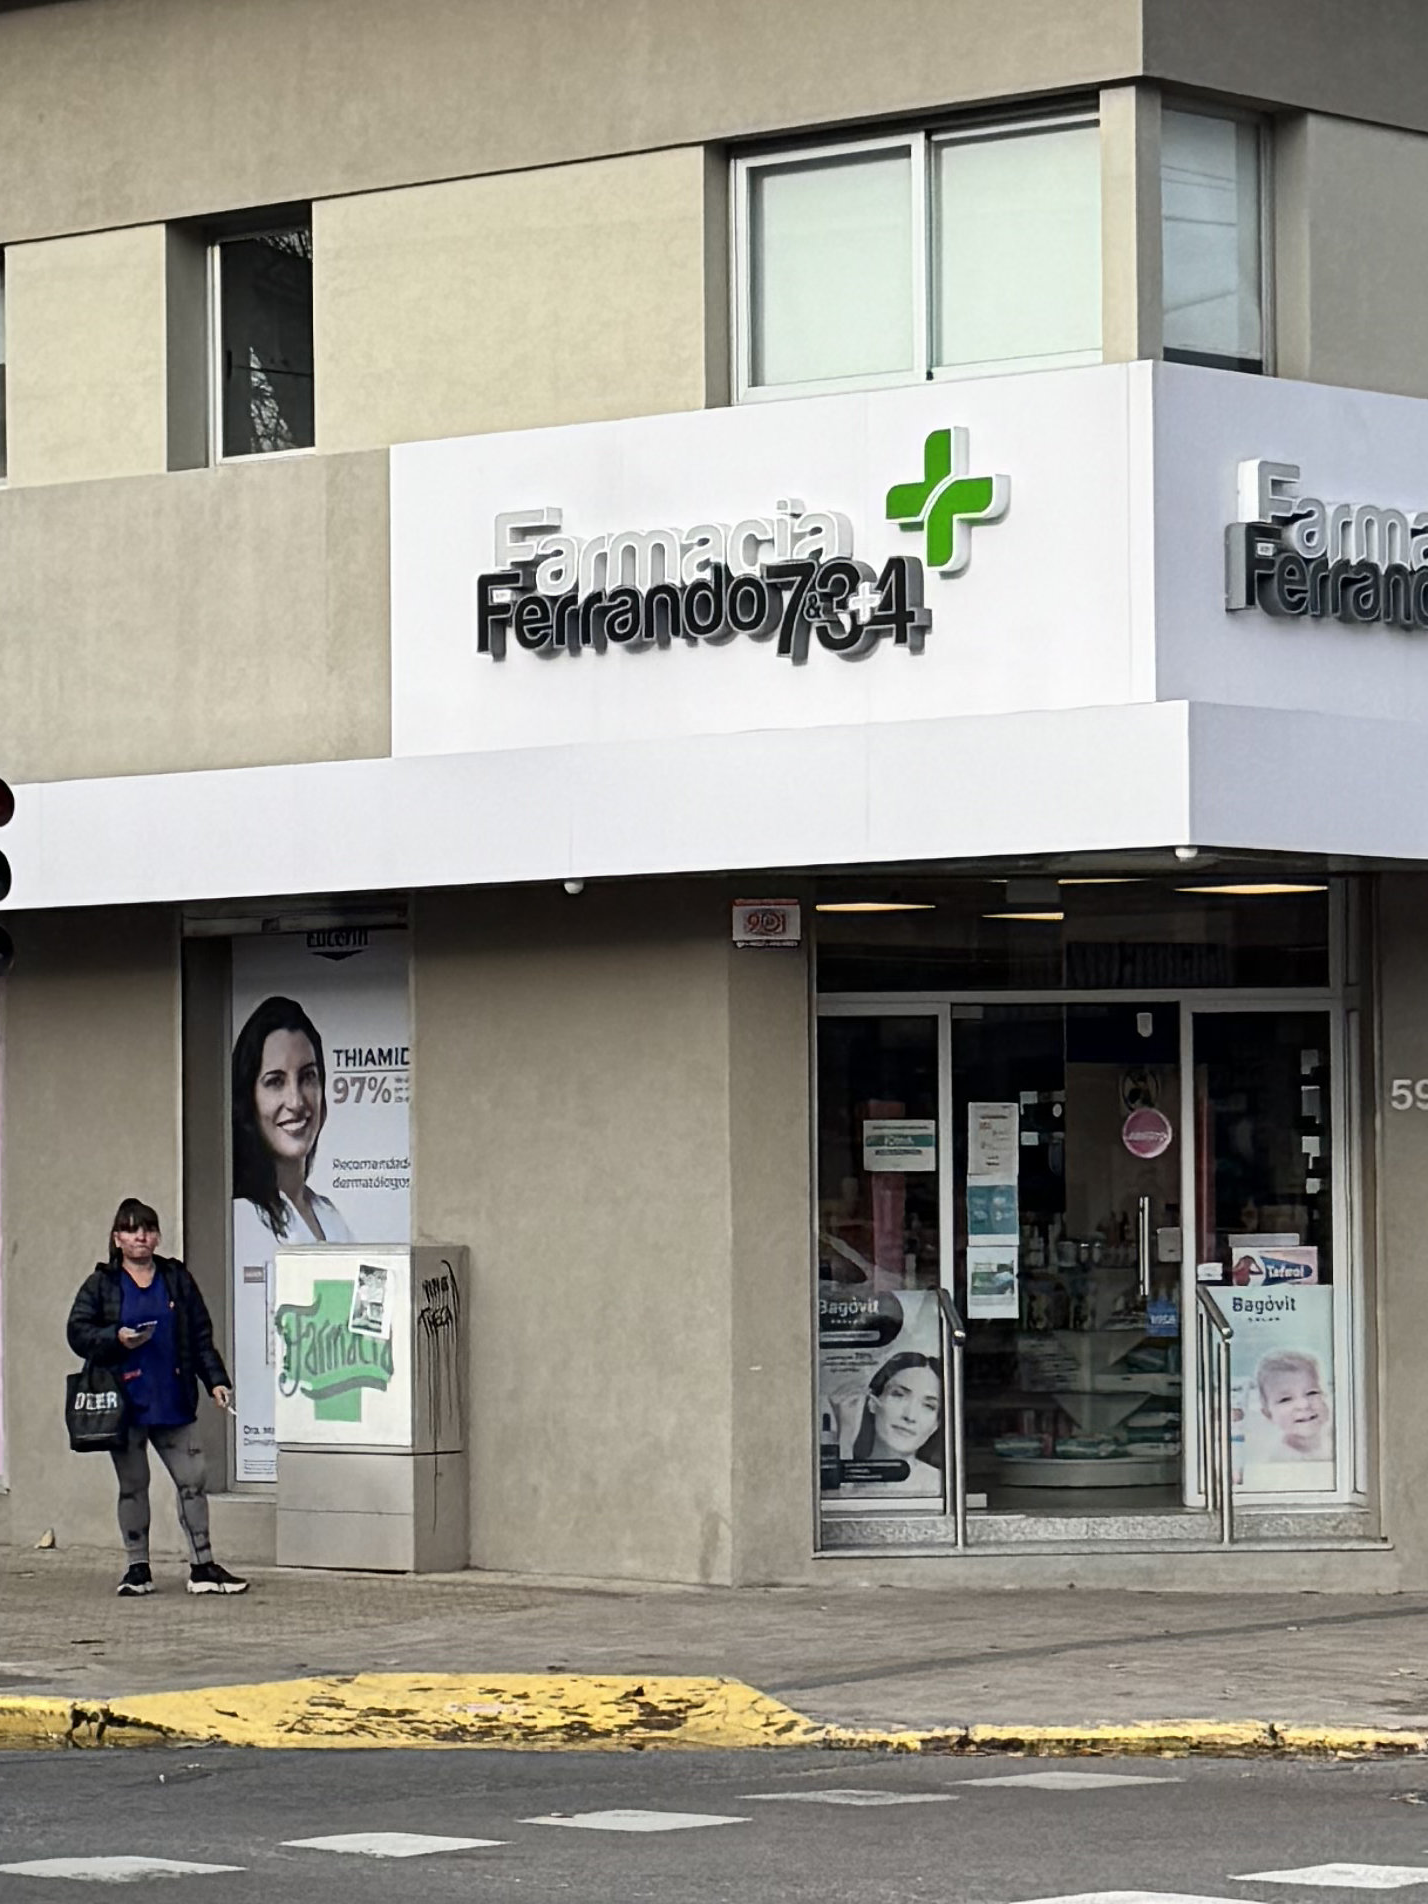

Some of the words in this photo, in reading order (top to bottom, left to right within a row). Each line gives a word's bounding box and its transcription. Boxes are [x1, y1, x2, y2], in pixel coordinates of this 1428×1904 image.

[493, 498, 854, 594] Farmacia
[476, 562, 776, 659] Ferrando
[332, 1075, 392, 1104] 97%
[332, 1158, 410, 1170] Recomendad
